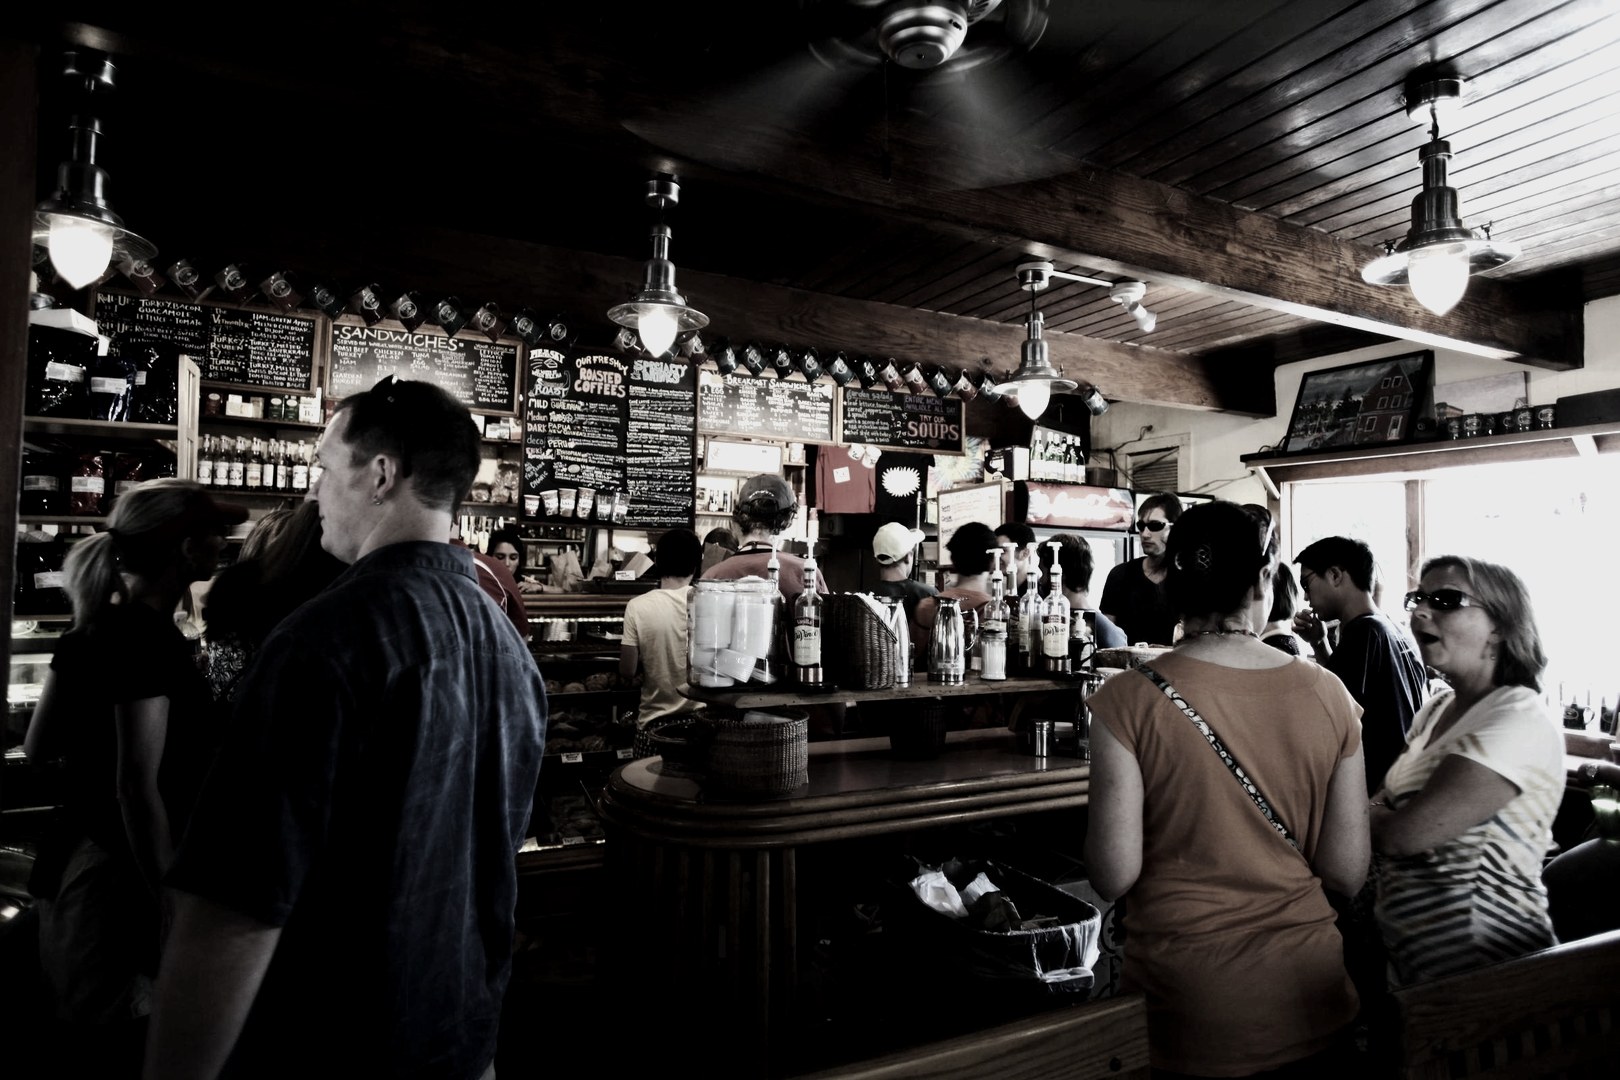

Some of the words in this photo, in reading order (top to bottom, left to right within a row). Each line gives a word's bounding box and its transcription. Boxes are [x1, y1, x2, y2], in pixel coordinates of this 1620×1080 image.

[340, 326, 458, 351] SANDWICHES
[575, 355, 592, 368] OUR
[592, 355, 629, 376] FRESHLY
[579, 367, 622, 385] ROASTED
[726, 373, 769, 389] BREAKFAST
[768, 378, 812, 392] SANDWICHES
[574, 379, 626, 398] COFFEES
[528, 398, 549, 409] MILD
[526, 422, 548, 433] DARK
[920, 414, 932, 423] TRY
[907, 420, 960, 442] SOUPS
